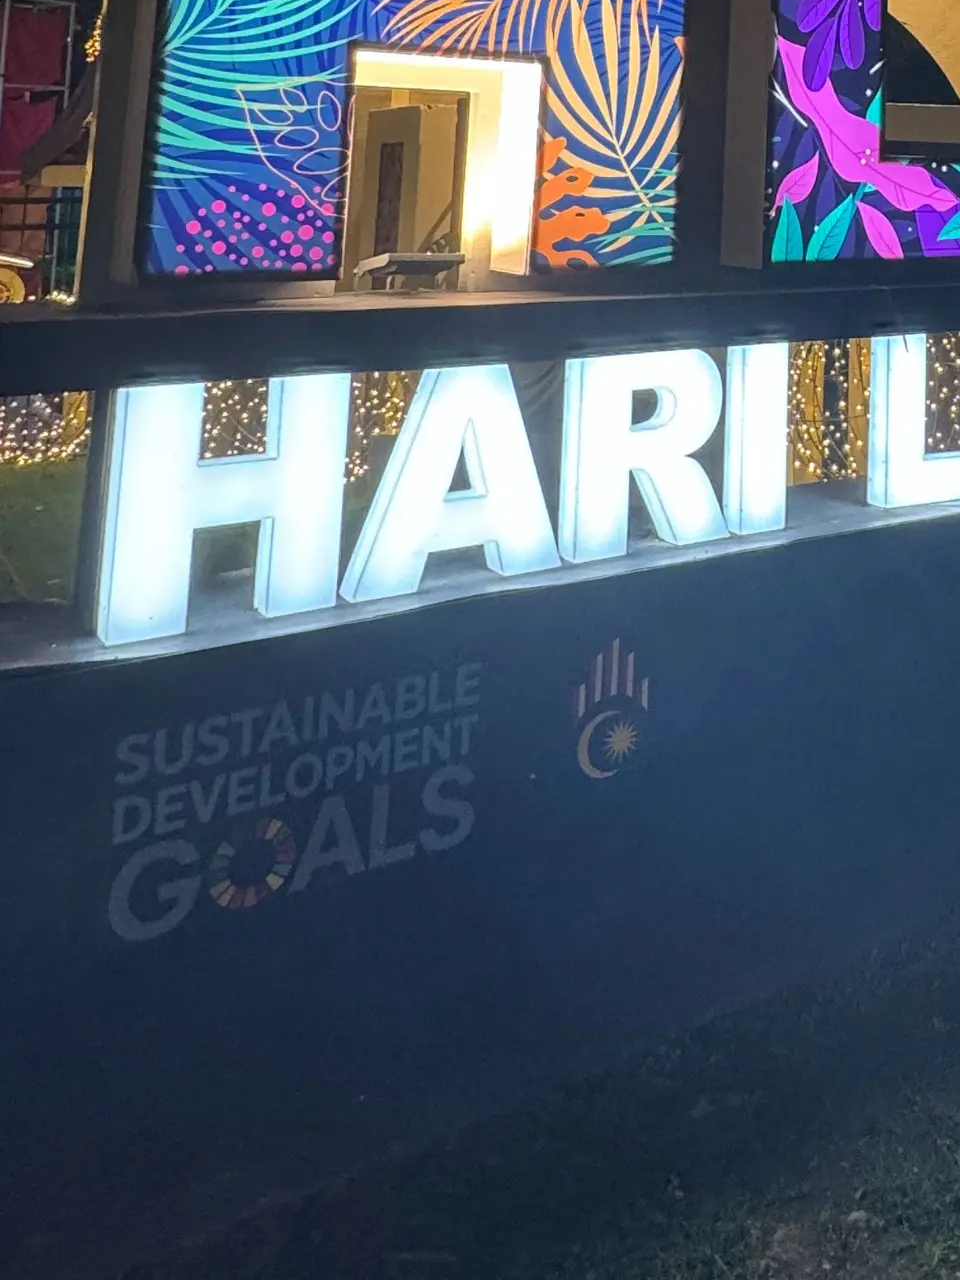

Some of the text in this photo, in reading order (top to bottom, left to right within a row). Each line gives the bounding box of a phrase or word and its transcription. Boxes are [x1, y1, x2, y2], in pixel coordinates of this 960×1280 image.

[97, 342, 788, 646] HARI
[111, 714, 481, 846] DEVELOPMENT
[113, 662, 483, 785] SUSTAINABLE
[107, 765, 476, 943] GOALS
